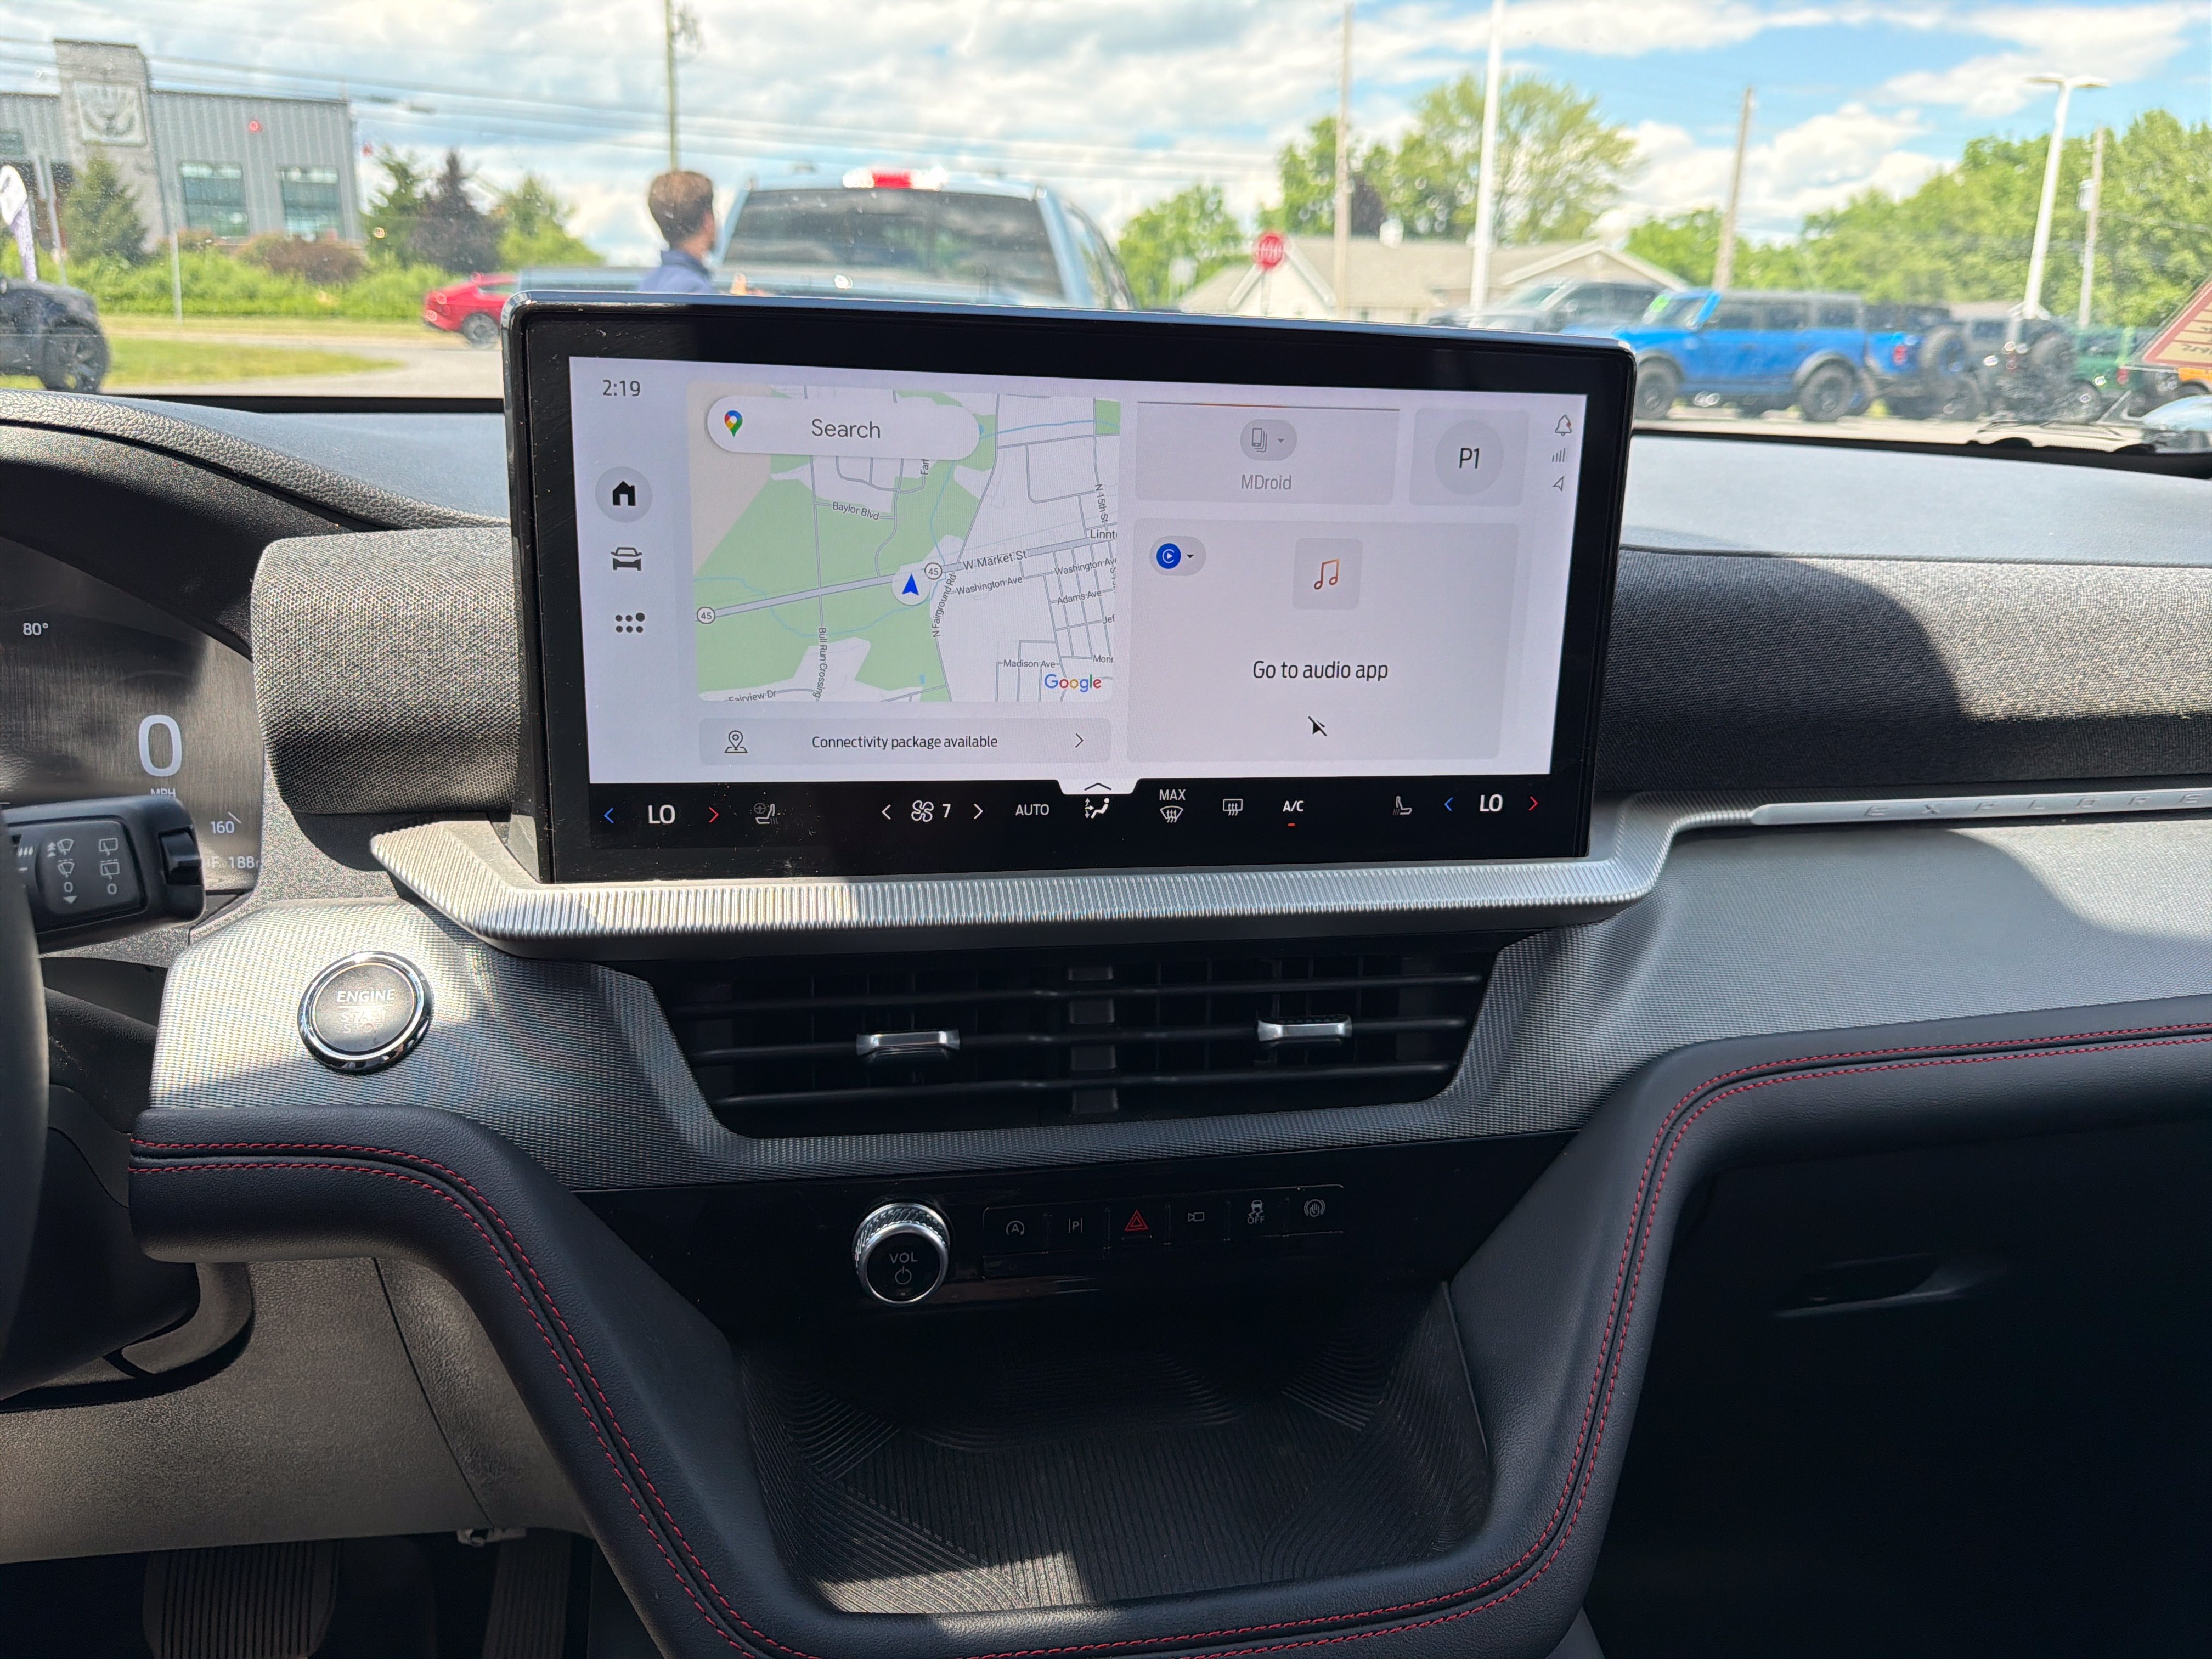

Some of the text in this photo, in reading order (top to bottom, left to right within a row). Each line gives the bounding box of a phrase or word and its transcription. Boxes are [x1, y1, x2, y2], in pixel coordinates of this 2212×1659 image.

[602, 380, 641, 397] 2:19
[811, 419, 881, 438] Search
[1459, 448, 1480, 469] P1
[1241, 475, 1291, 490] MDroid
[832, 502, 879, 521] Baylor Blvd
[1097, 495, 1107, 512] 15th
[963, 550, 1028, 570] W Market St
[1054, 562, 1102, 576] Washington
[956, 577, 1023, 595] Washington Ave
[931, 585, 952, 630] Fairground
[947, 574, 957, 586] Rd
[1057, 590, 1102, 605] Adams Ave
[22, 622, 49, 636] 80°
[813, 628, 828, 698] Bull Run Crossing
[1003, 659, 1056, 668] Madison Ave
[1252, 661, 1389, 682] Go to audio app
[1044, 674, 1102, 693] Google
[767, 690, 776, 699] Dr
[138, 714, 182, 777] 0
[812, 735, 998, 751] Connectivity package available
[1159, 789, 1186, 802] MAX
[1480, 795, 1503, 812] LO
[942, 803, 951, 819] 7
[1015, 803, 1049, 816] AUTO
[1283, 800, 1304, 812] A/C
[648, 805, 675, 824] LO
[211, 822, 235, 834] 160
[337, 989, 396, 1002] ENGINE
[1247, 1216, 1265, 1224] OFF
[889, 1254, 918, 1264] VOL
